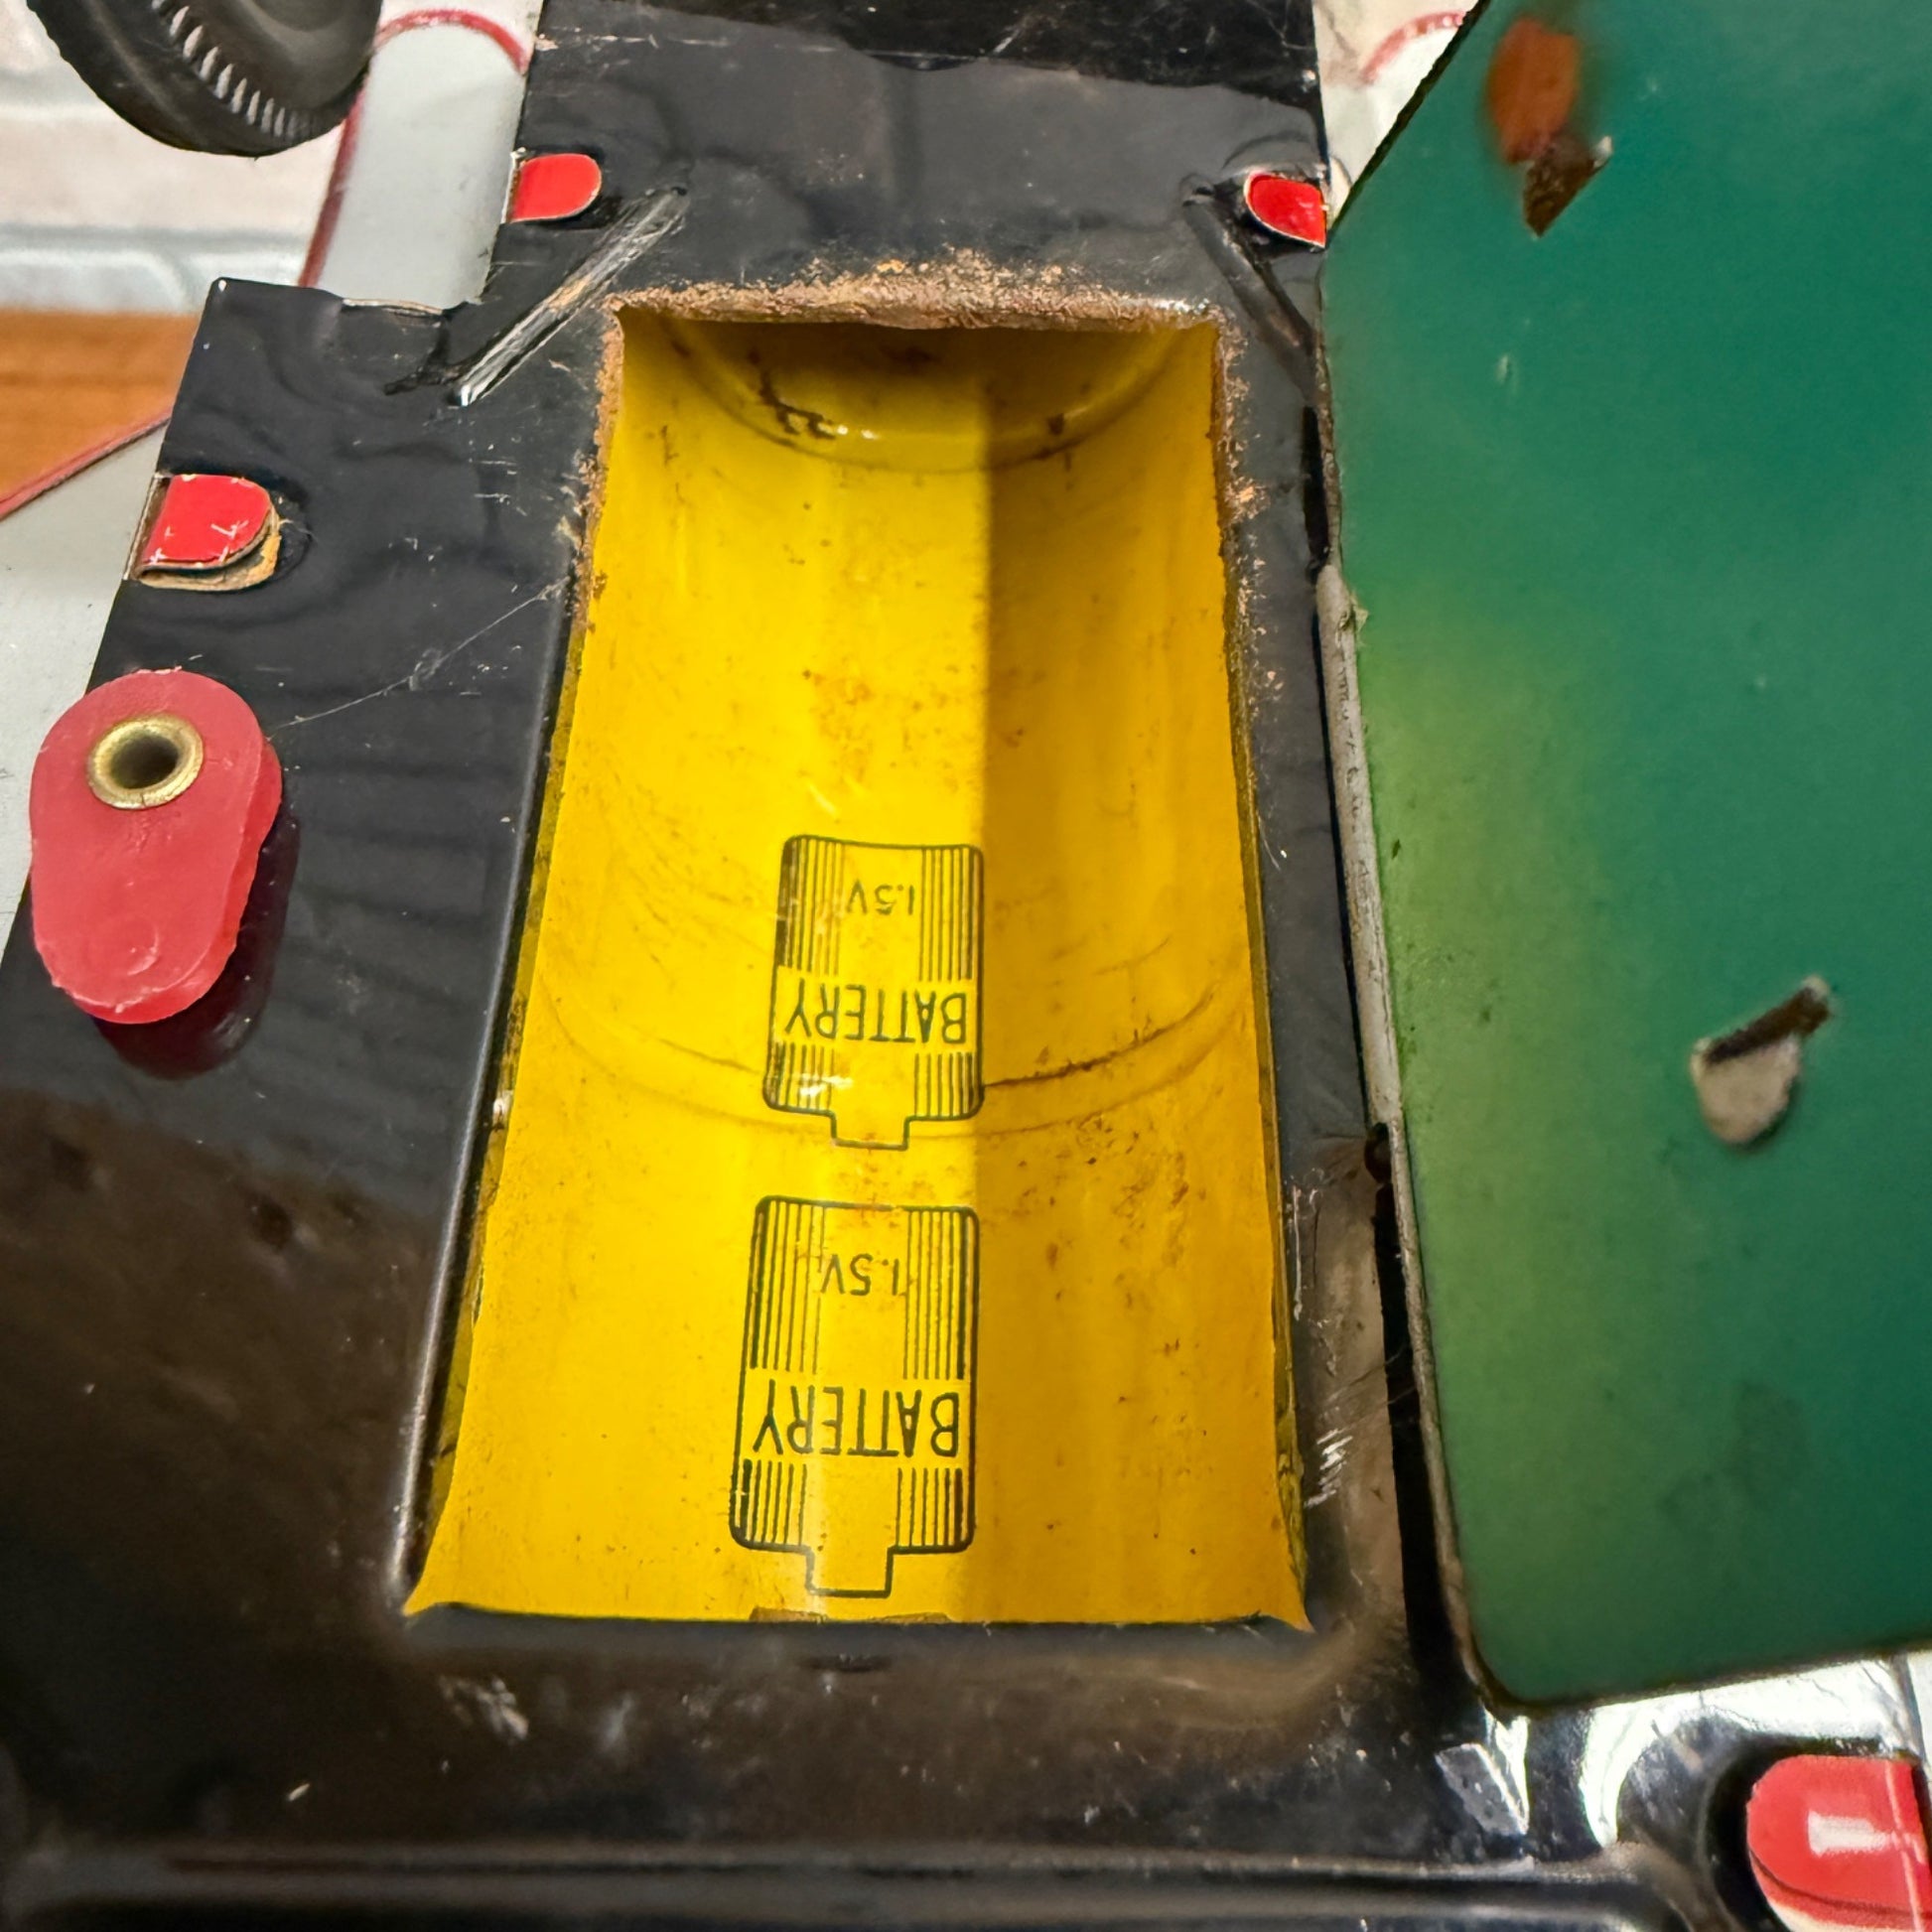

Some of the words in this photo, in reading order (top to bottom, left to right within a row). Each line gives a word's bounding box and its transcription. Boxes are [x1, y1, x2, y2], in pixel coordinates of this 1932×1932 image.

[846, 880, 915, 915] 1.5V
[784, 978, 967, 1044] BATTERY
[820, 1254, 900, 1296] 1.5V
[753, 1379, 959, 1457] BATTERY
